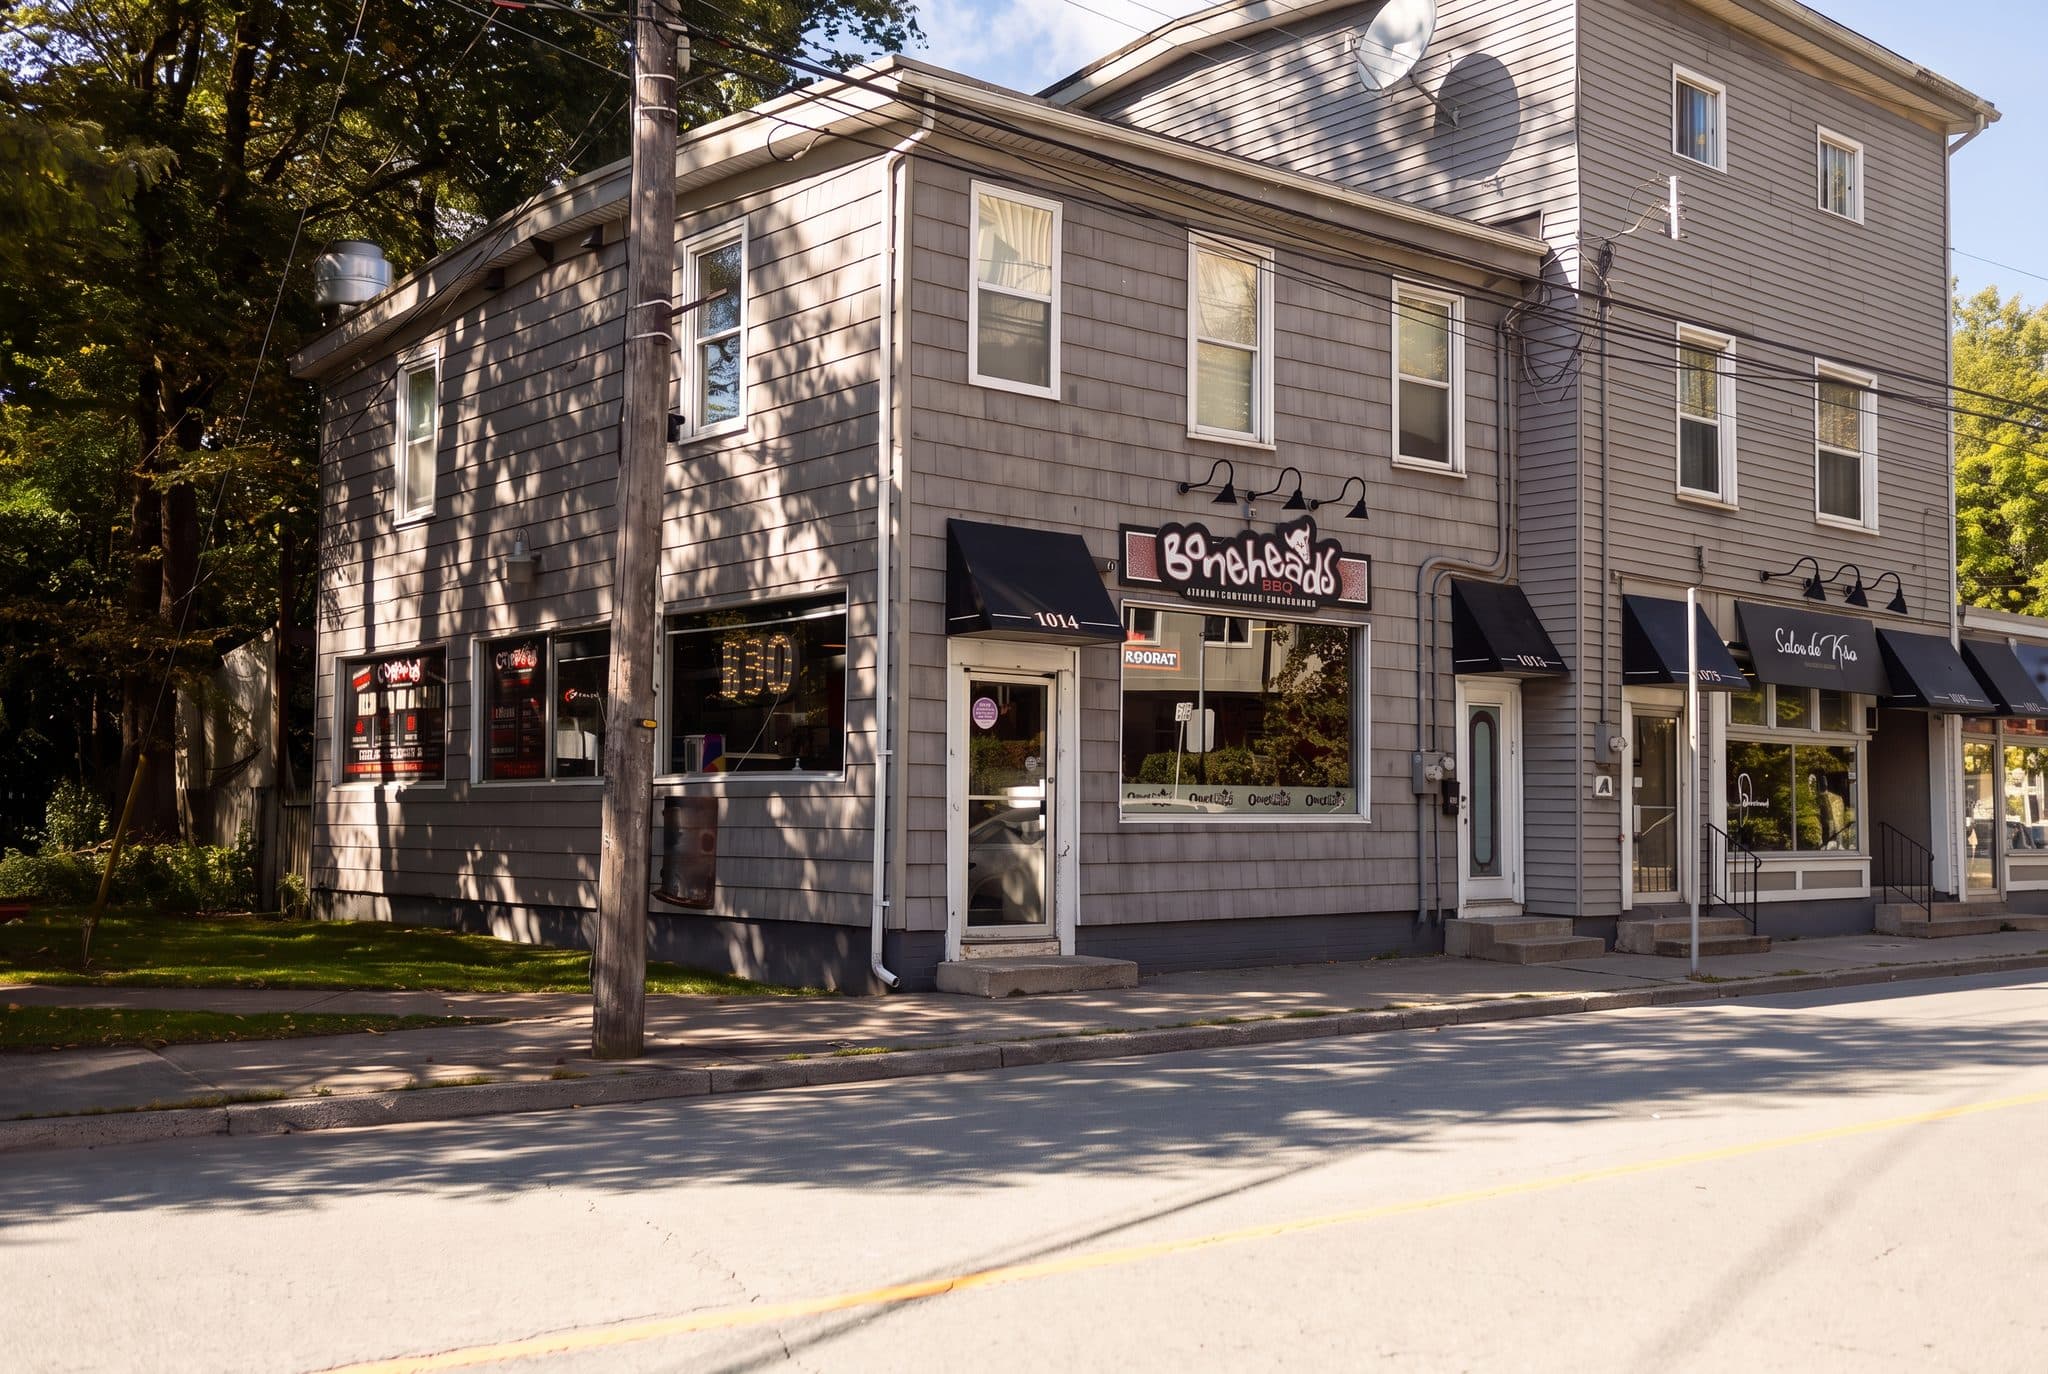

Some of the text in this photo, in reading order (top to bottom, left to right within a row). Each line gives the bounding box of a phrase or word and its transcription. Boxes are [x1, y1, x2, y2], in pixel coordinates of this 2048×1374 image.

[1163, 531, 1336, 596] Boneheads
[1262, 579, 1293, 595] BBQ
[1034, 611, 1080, 630] 1014
